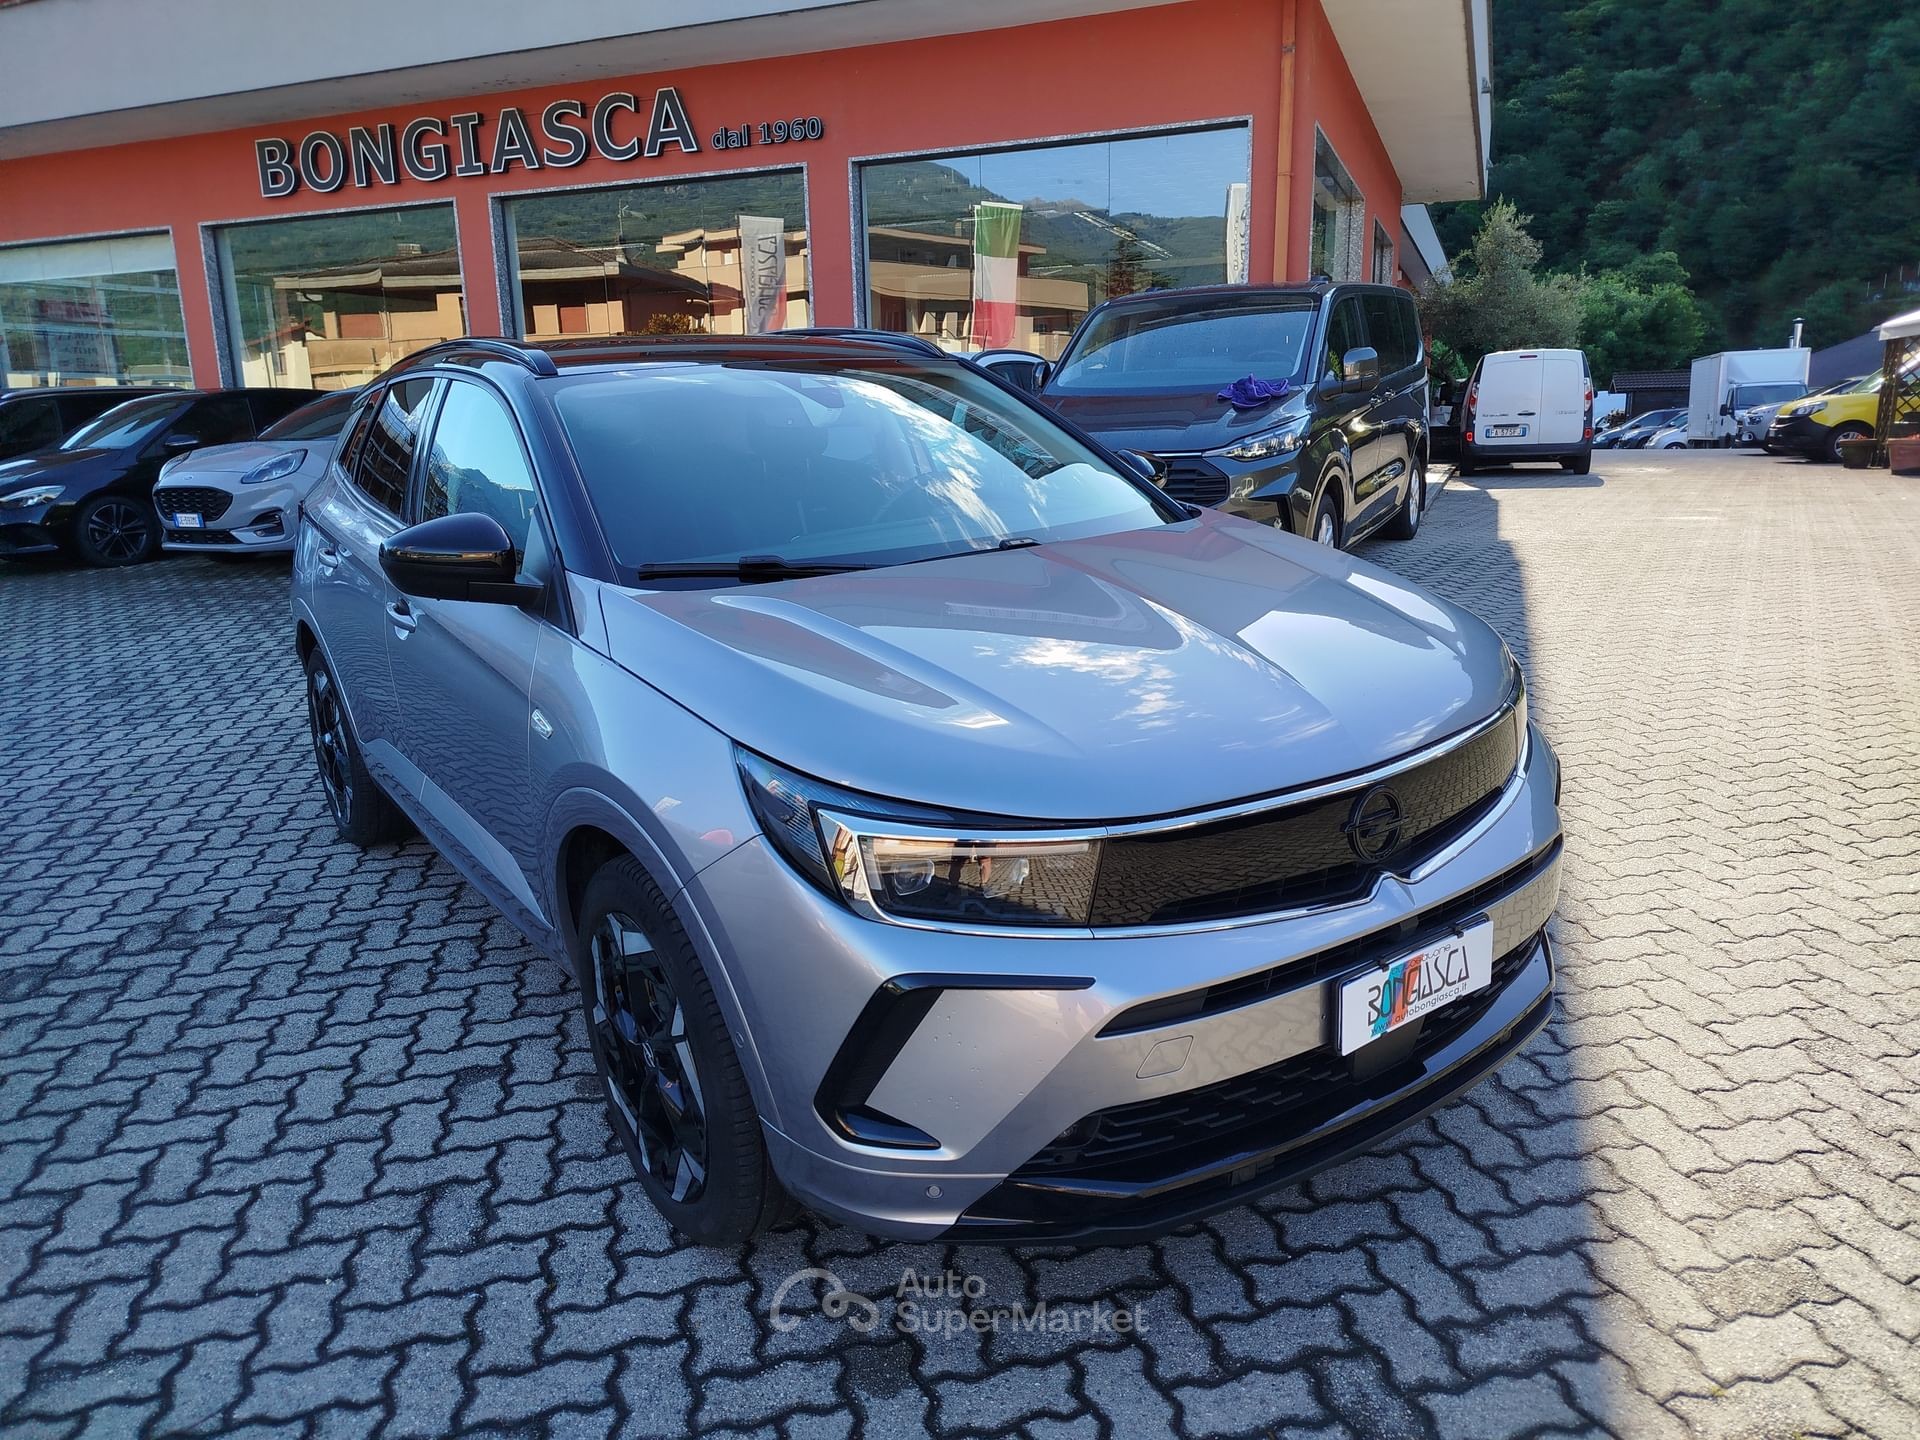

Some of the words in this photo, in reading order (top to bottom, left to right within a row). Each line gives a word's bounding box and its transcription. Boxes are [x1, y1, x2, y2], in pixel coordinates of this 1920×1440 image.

[255, 86, 700, 198] BONGIASCA
[711, 124, 750, 151] dal
[758, 115, 824, 147] 1960
[1367, 945, 1470, 1027] BONGIASCA
[1370, 984, 1468, 1037] www.autobongiasca.it
